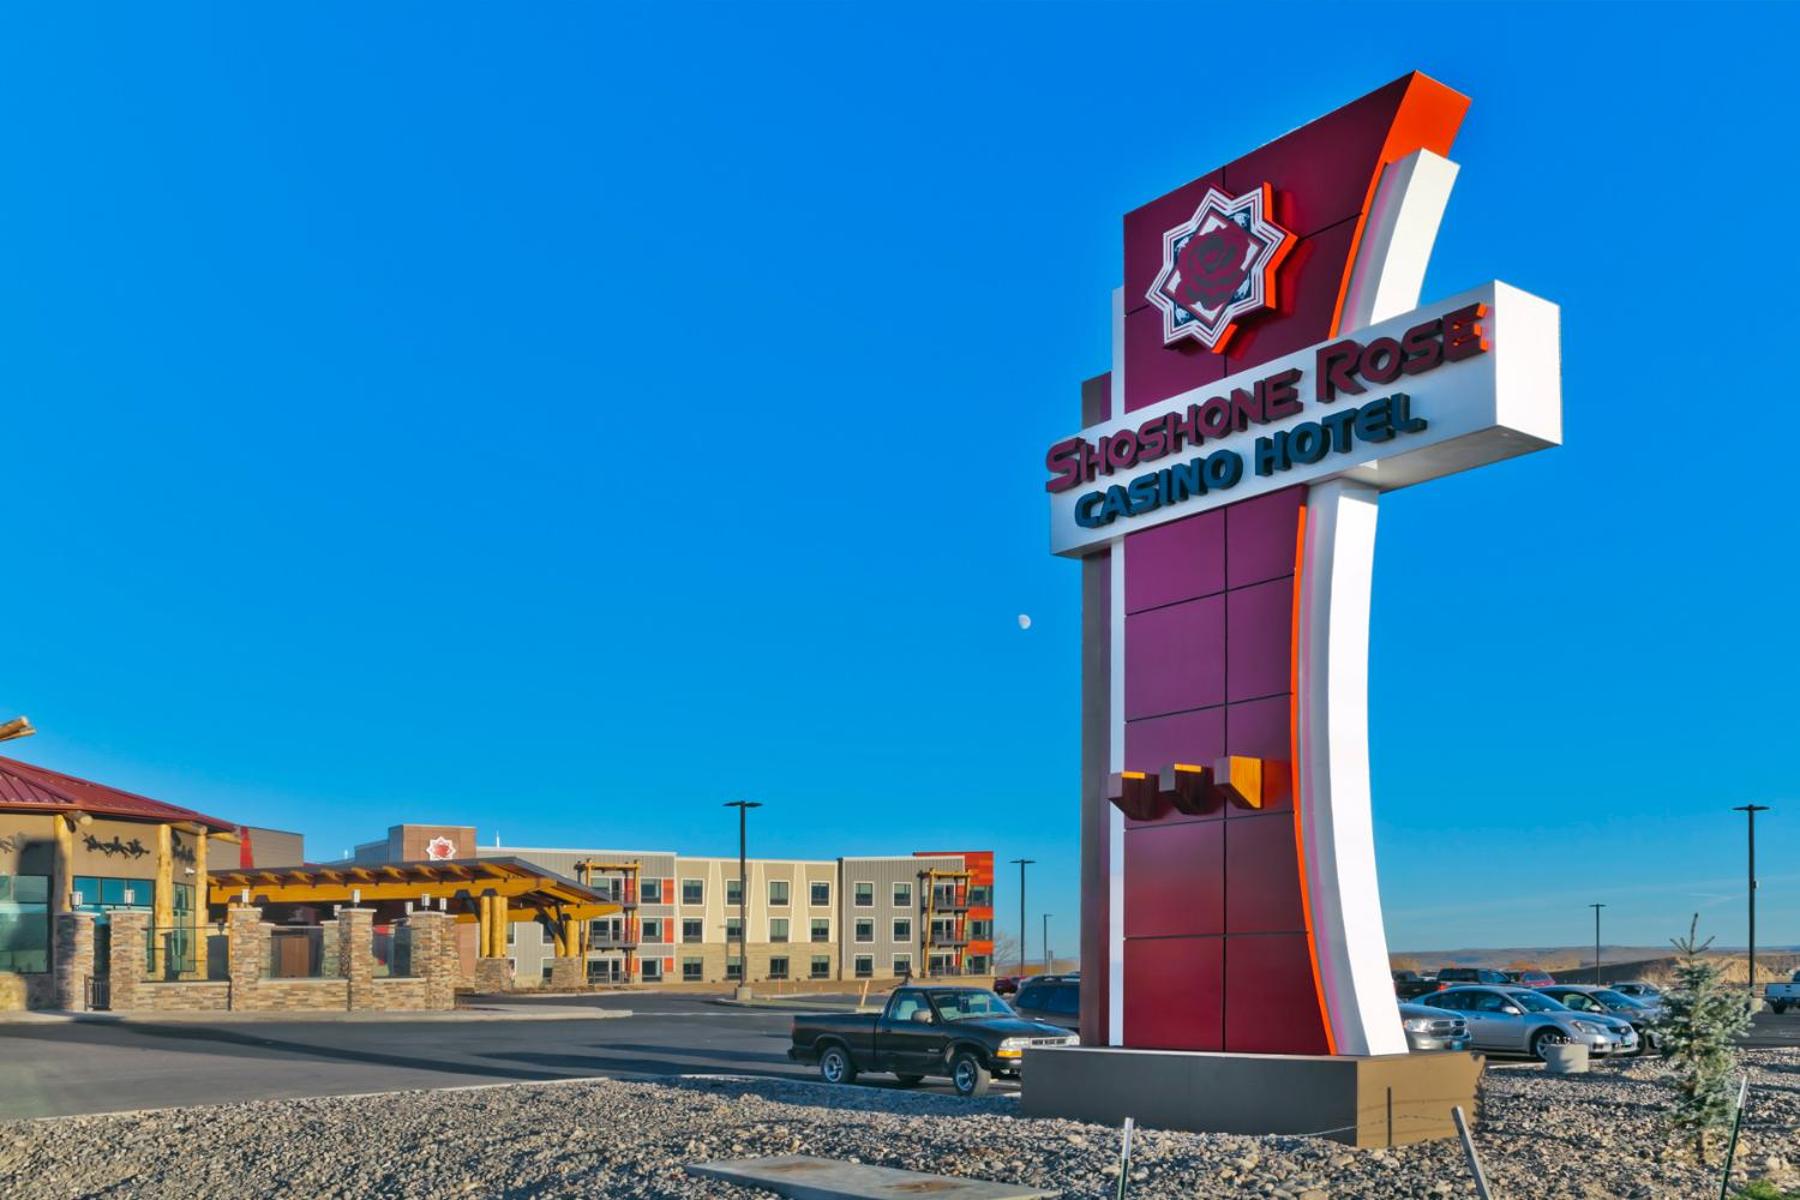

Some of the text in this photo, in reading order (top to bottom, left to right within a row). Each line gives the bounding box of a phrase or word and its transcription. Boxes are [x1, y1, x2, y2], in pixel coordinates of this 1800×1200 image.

[1046, 302, 1489, 494] SHOSHONE ROSE
[1074, 393, 1428, 528] CASINO HOTEL
